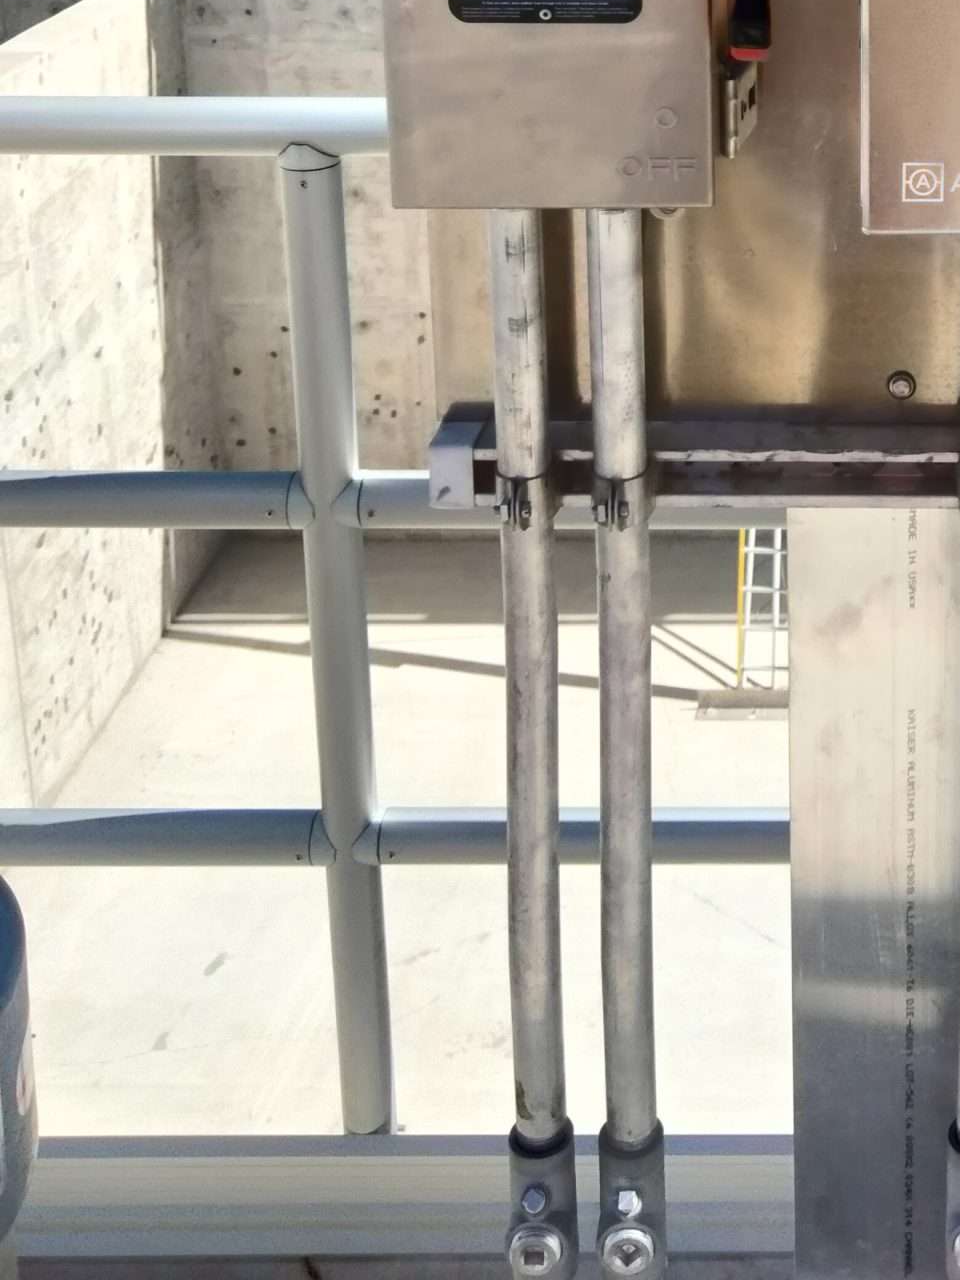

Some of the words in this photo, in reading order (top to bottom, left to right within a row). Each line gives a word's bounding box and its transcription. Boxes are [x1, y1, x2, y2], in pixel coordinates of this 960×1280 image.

[615, 154, 697, 182] OFF
[907, 549, 917, 565] IN
[906, 708, 916, 755] KAISER
[906, 760, 916, 822] ALUMINUM
